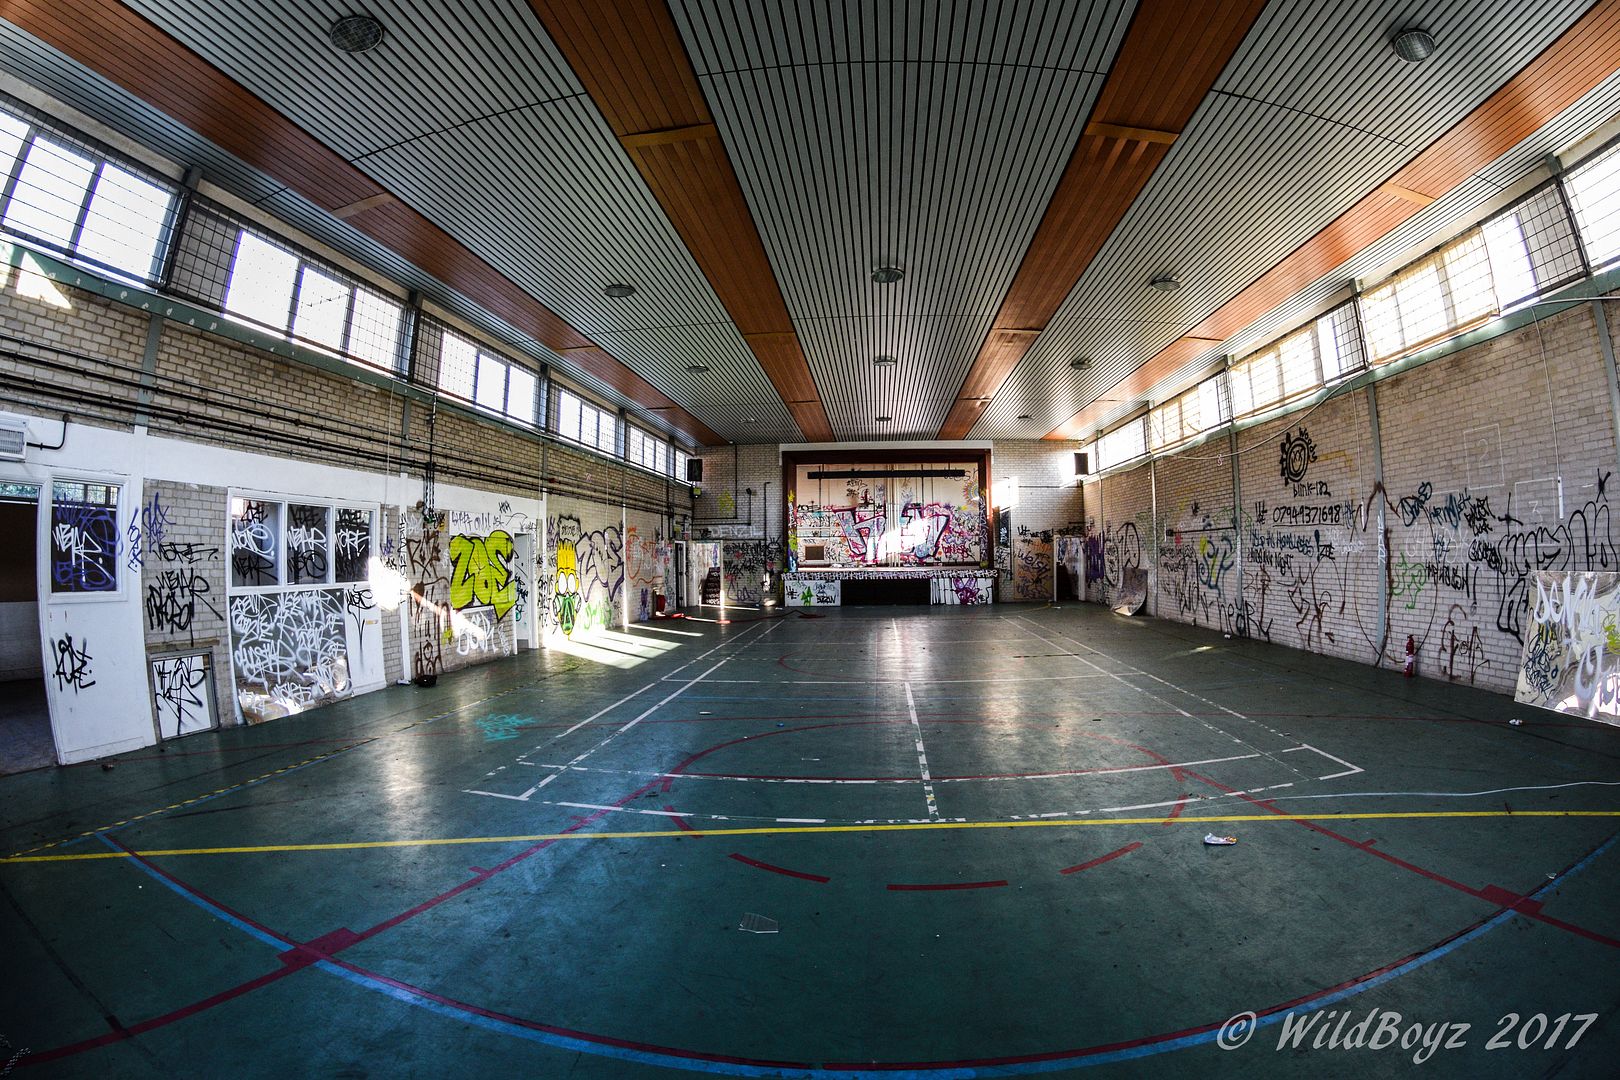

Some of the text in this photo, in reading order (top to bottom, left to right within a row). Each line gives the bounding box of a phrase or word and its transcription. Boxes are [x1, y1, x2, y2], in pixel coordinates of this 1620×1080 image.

[1293, 480, 1331, 497] blink-182
[1273, 505, 1340, 524] 07949371698
[1528, 500, 1543, 528] 3
